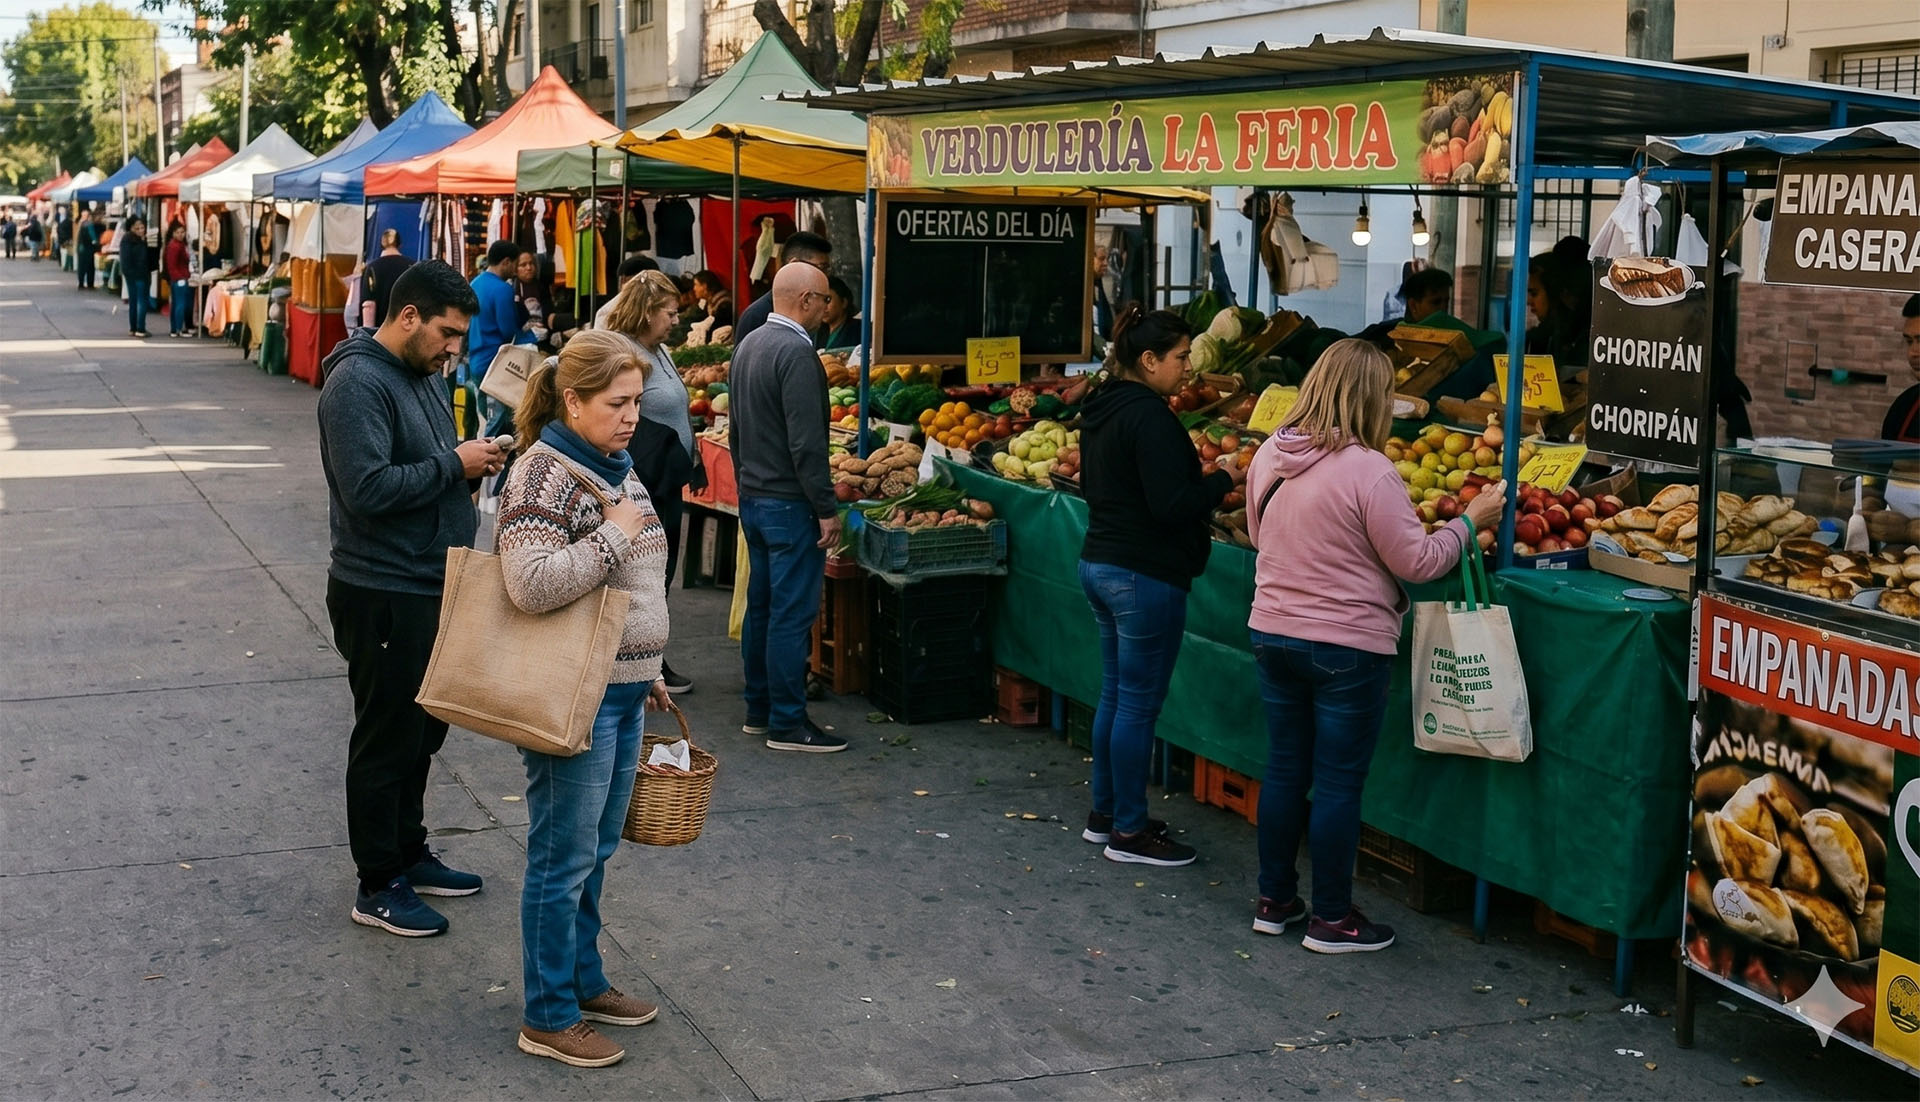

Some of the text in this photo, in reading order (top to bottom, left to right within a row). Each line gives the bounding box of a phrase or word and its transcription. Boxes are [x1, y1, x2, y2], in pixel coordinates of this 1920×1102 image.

[920, 101, 1398, 177] VERDULERÍA LA FERIA
[1779, 174, 1920, 217] EMPANA
[897, 207, 1074, 238] OFERTAS DEL DÍA
[1795, 228, 1920, 272] CASERA
[1593, 336, 1703, 373] CHORIPÁN
[1591, 403, 1699, 445] CHORIPÁN
